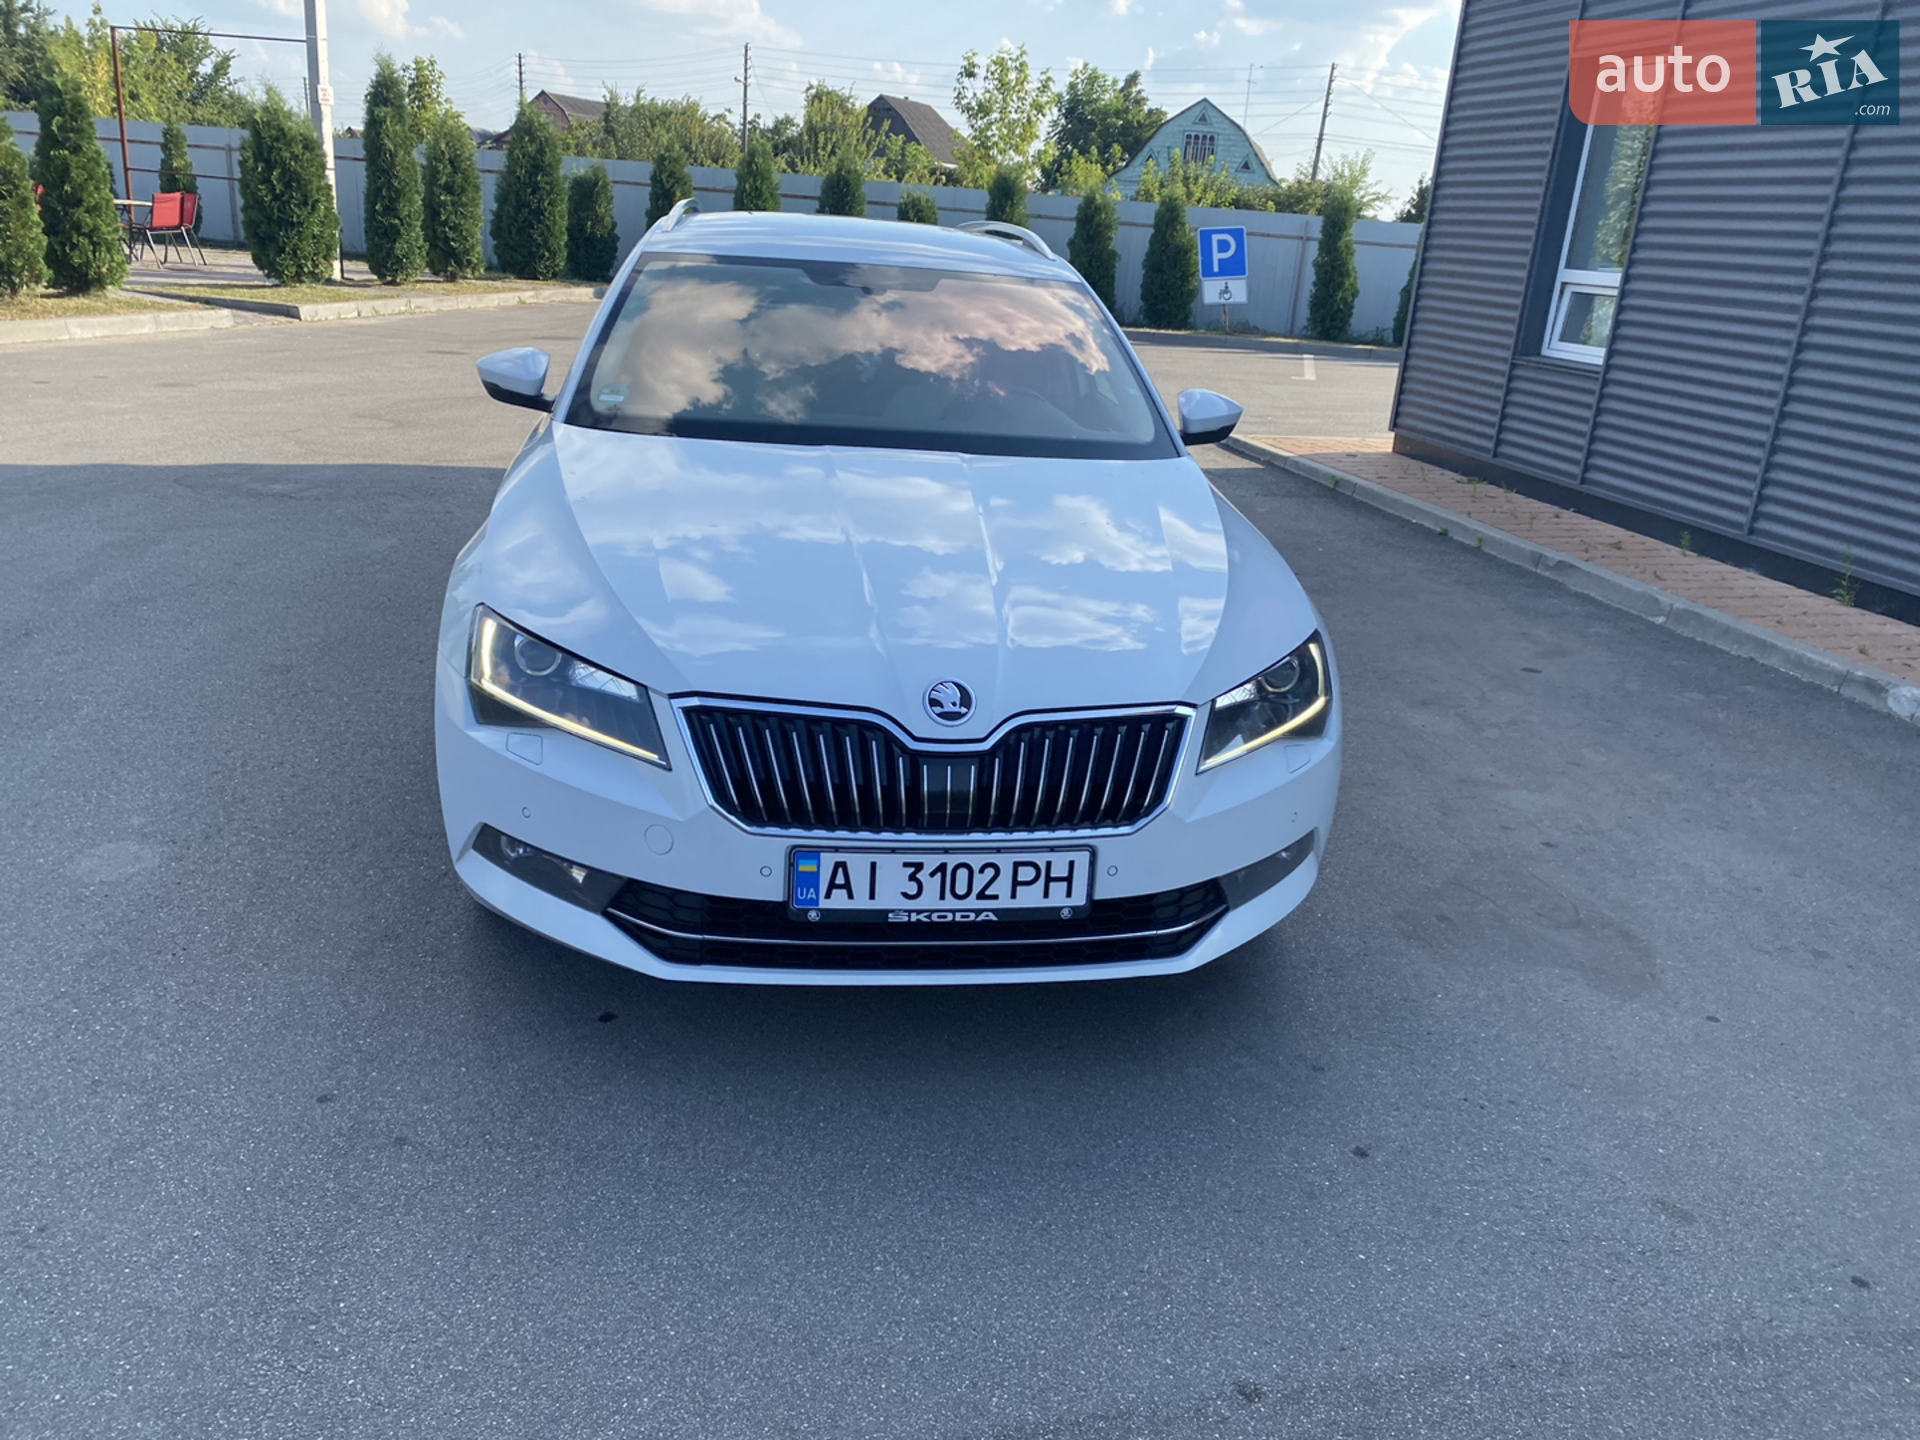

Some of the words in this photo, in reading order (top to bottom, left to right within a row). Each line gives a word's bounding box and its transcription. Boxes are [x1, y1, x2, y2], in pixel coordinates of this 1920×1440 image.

[1211, 233, 1237, 273] P
[797, 888, 817, 900] UA
[824, 860, 877, 900] AI
[900, 861, 1001, 901] 3102
